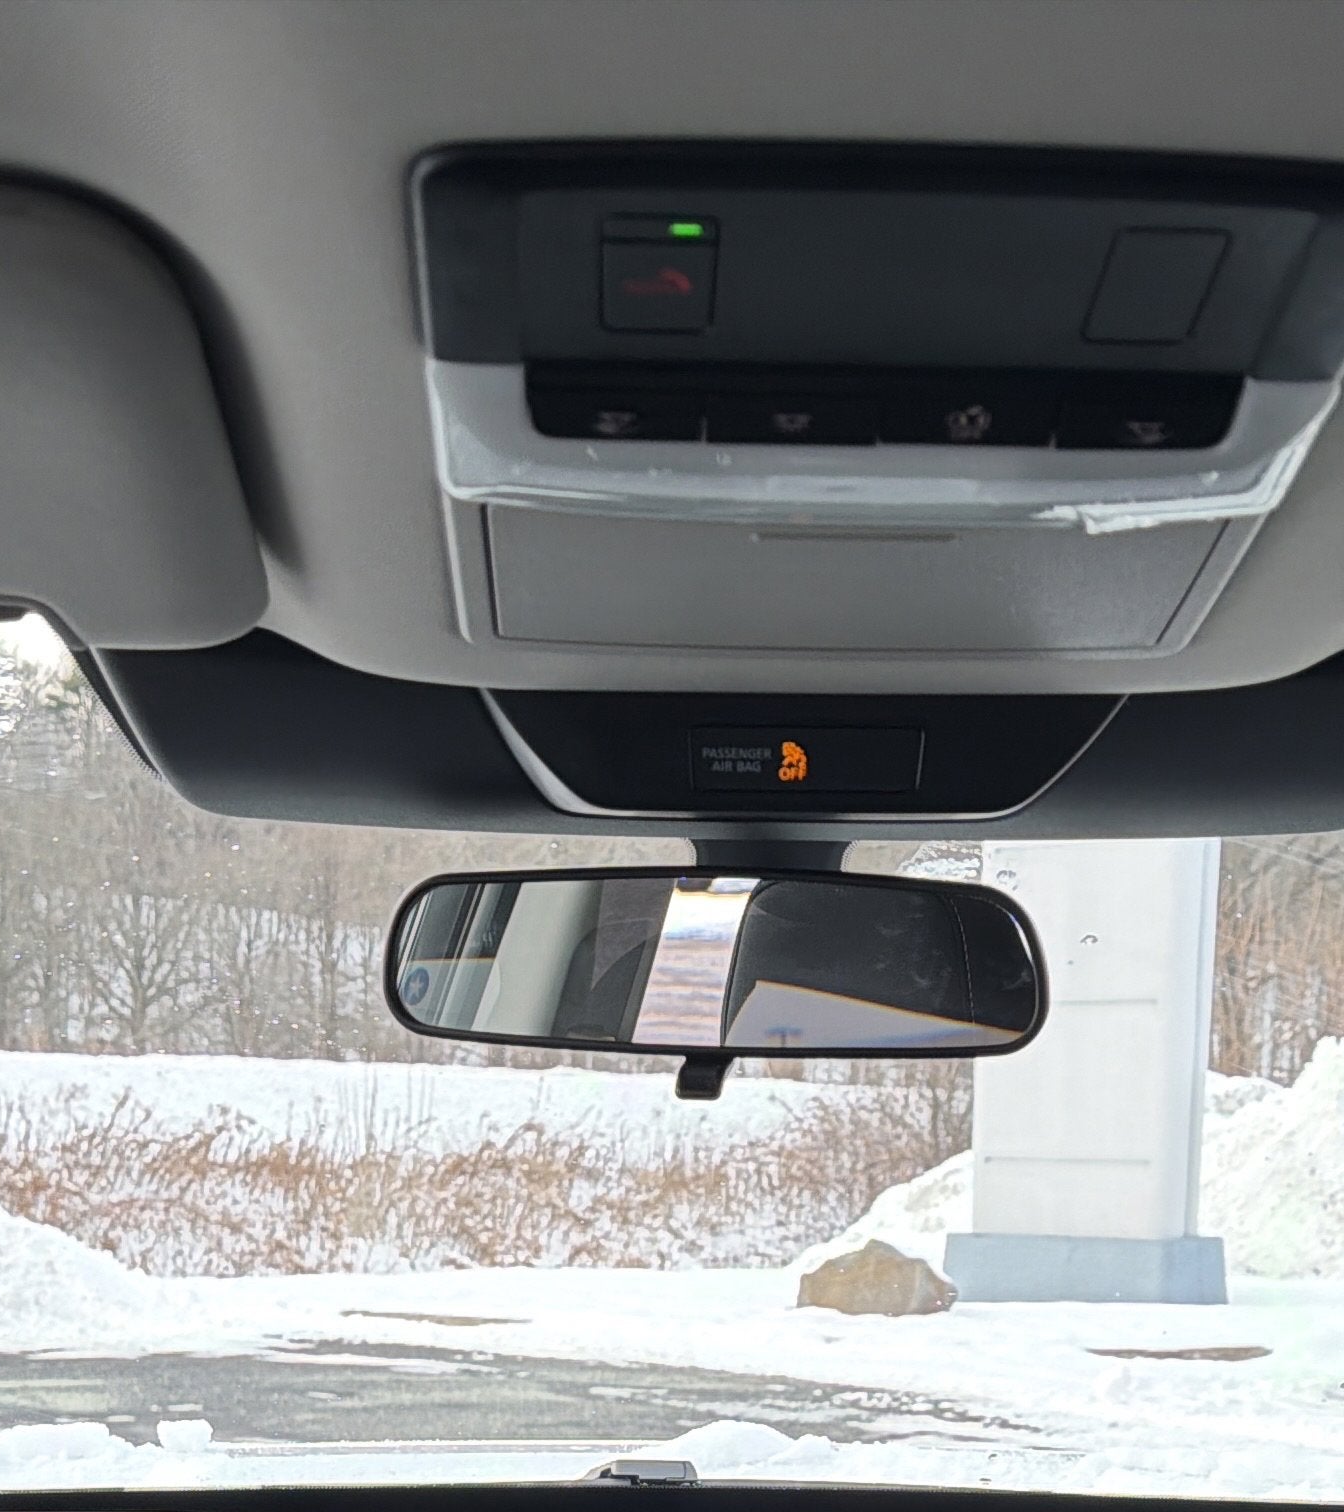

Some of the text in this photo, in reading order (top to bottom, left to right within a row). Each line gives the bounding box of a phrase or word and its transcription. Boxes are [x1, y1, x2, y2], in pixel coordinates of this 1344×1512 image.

[702, 747, 772, 759] PASSENGER
[711, 761, 761, 772] AIR BAG
[778, 767, 806, 781] OFF
